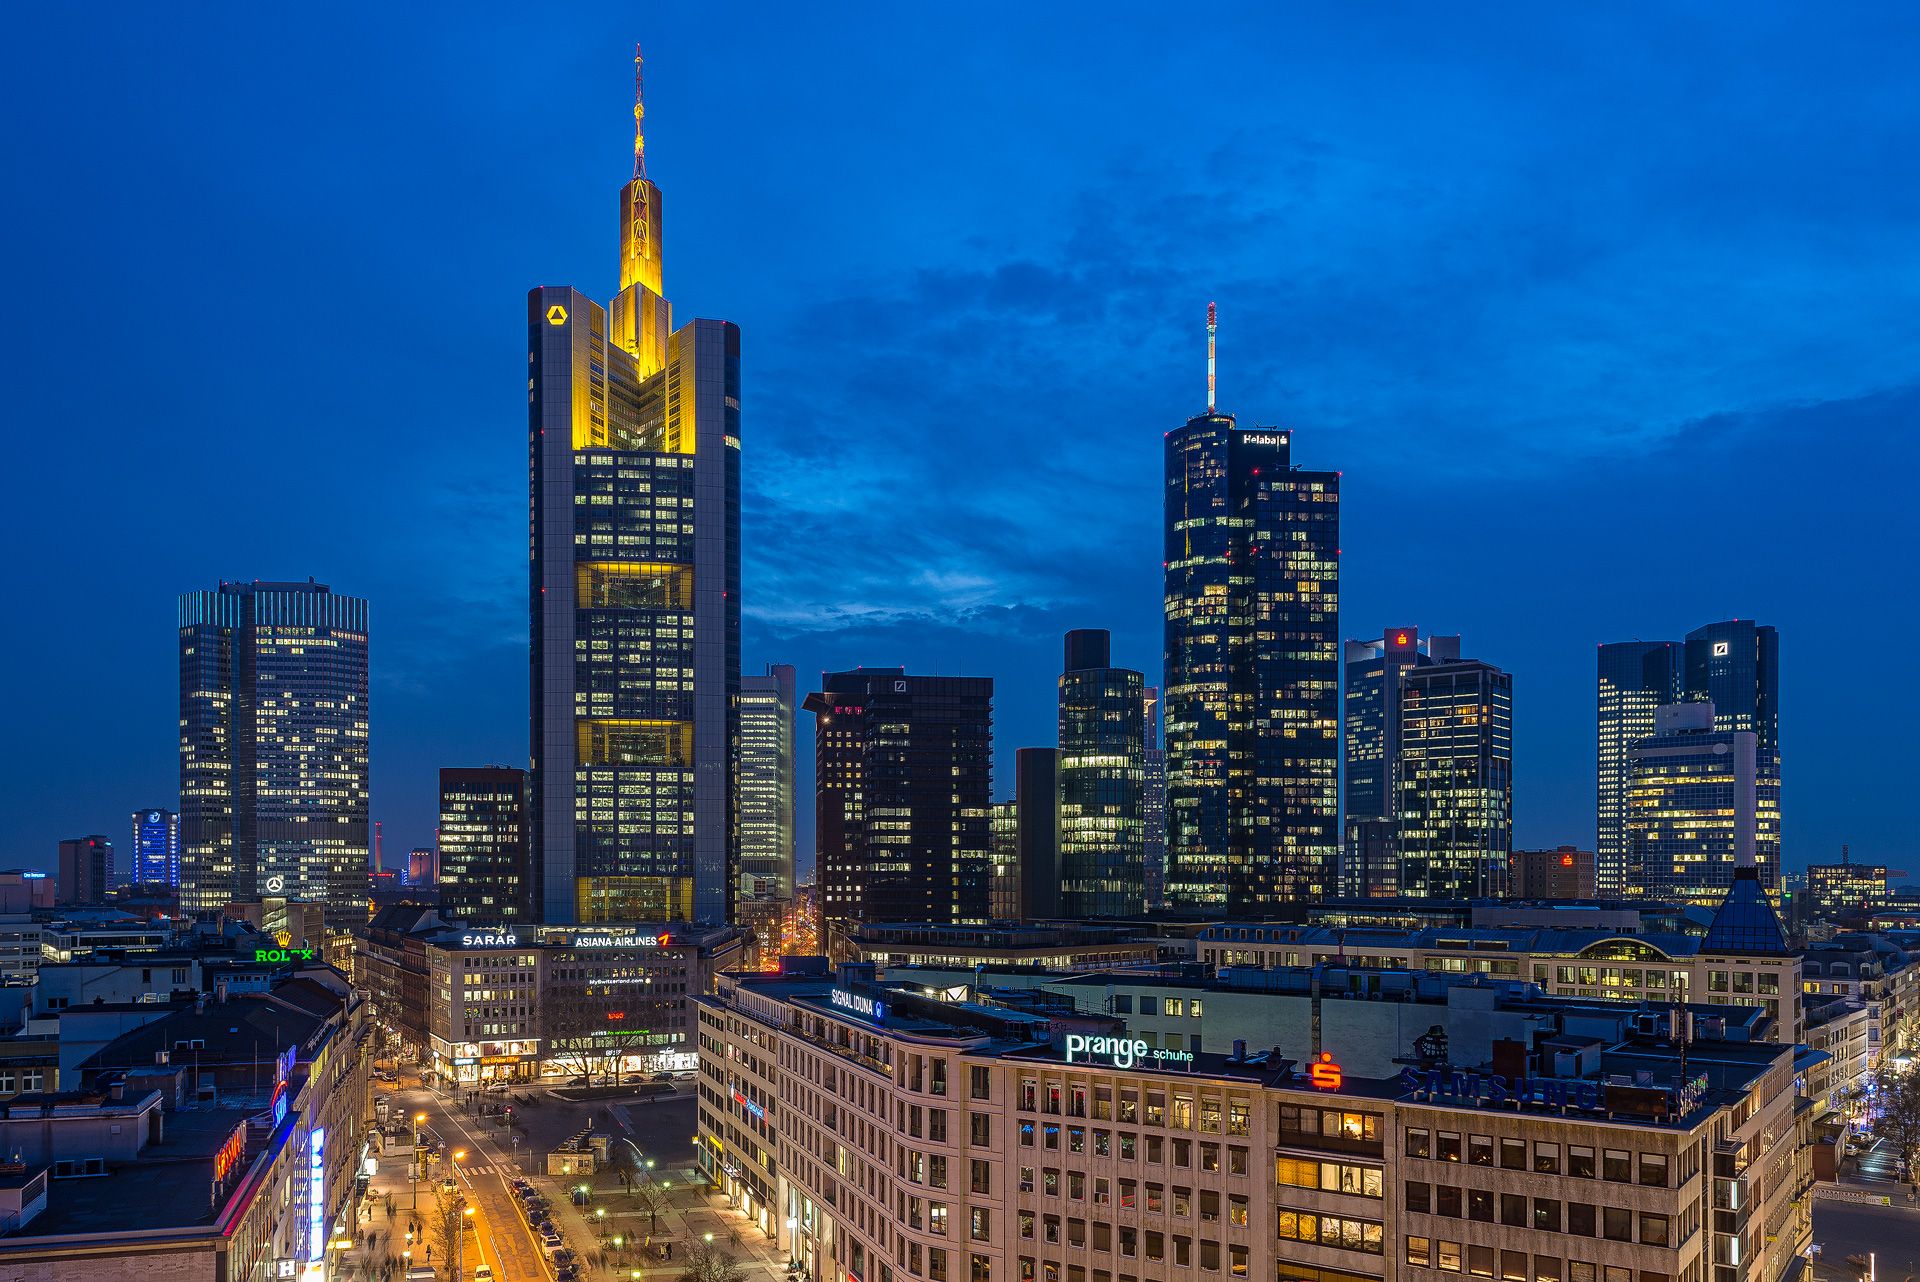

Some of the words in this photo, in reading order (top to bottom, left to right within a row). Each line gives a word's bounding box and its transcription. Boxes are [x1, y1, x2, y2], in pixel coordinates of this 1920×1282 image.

[1243, 435, 1276, 445] Helaba
[463, 935, 516, 945] SARAR
[576, 937, 612, 947] ASIANA
[614, 936, 657, 947] AIRLINES
[256, 949, 313, 962] ROLX
[832, 989, 853, 1009] SIGNAL
[853, 995, 873, 1015] IDUNA
[1066, 1034, 1148, 1069] prange
[1153, 1049, 1194, 1062] schuhe
[1400, 1066, 1598, 1110] SAMSUNG
